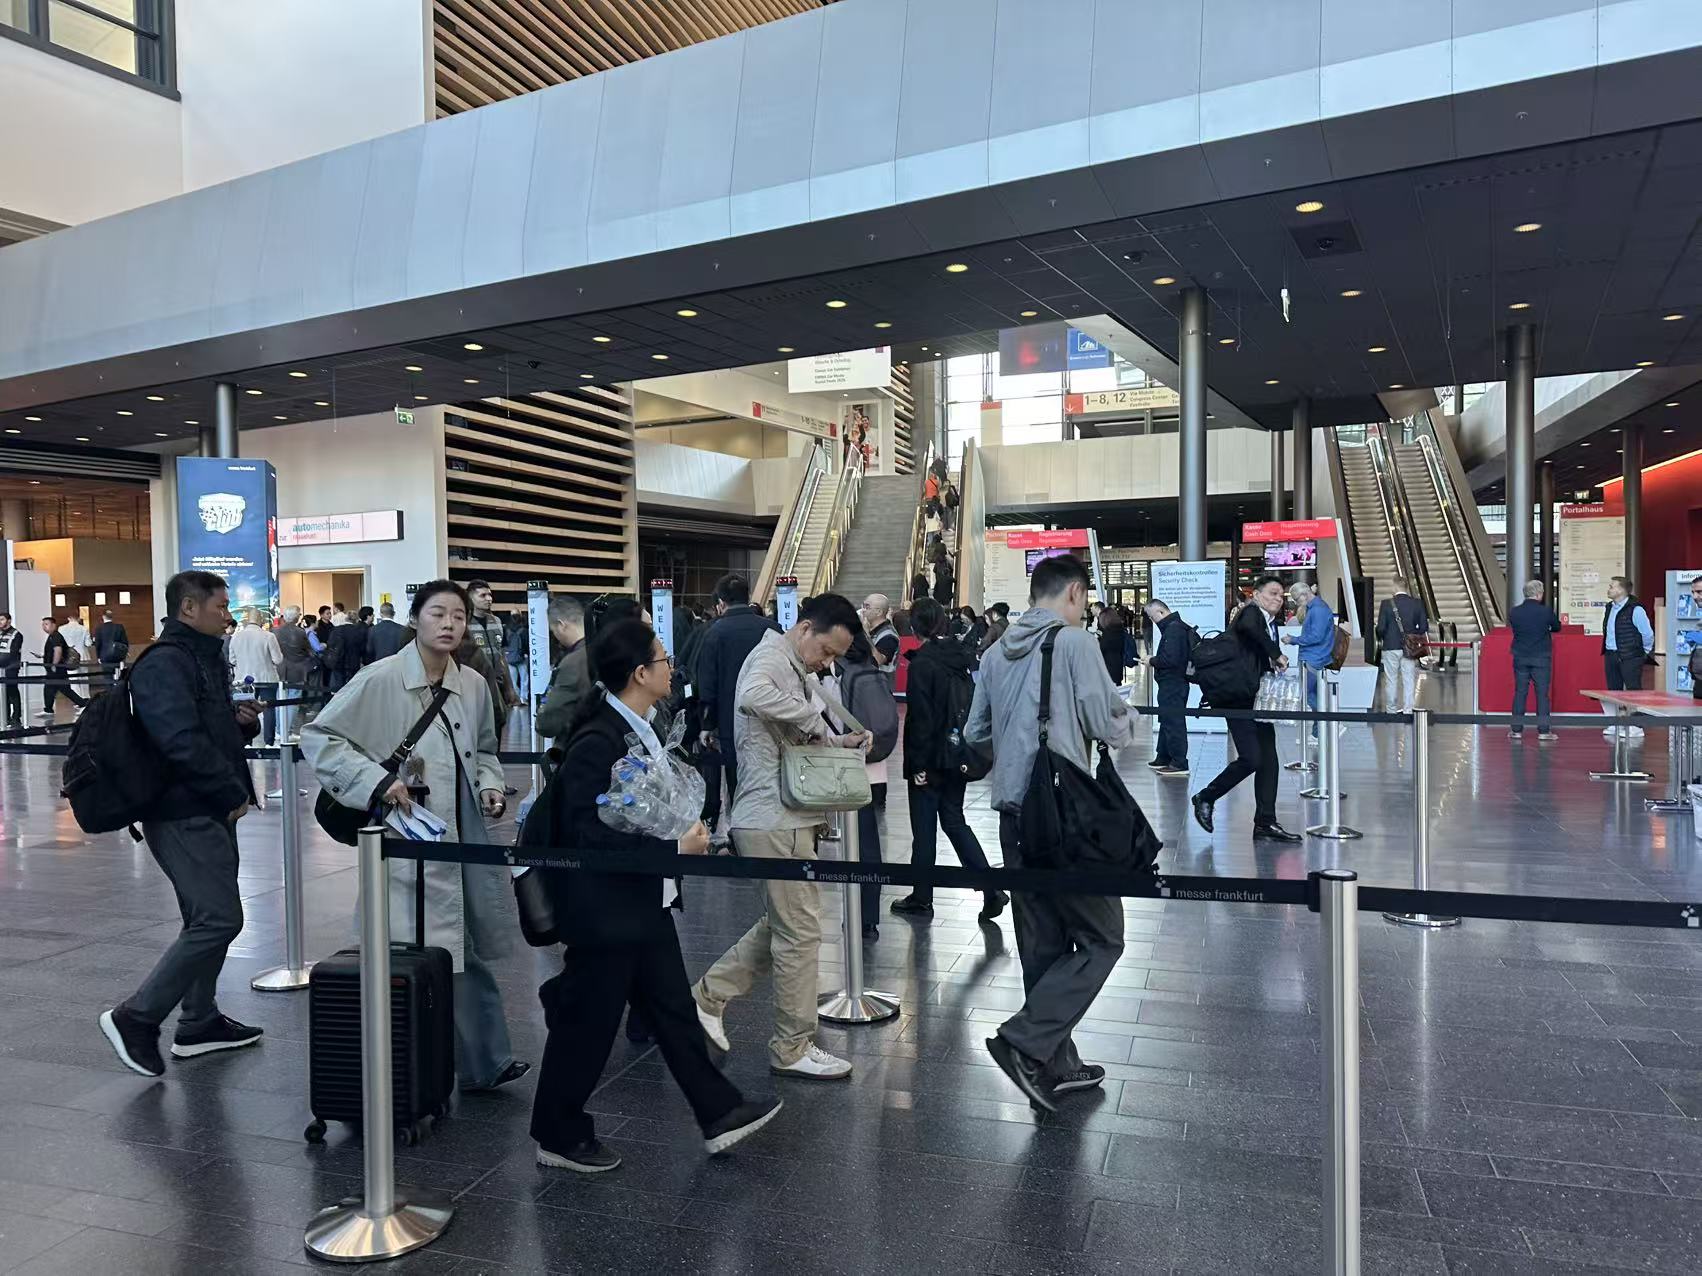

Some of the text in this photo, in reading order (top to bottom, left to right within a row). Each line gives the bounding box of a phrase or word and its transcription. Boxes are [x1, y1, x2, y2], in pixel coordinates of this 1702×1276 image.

[1113, 392, 1126, 403] 12
[292, 519, 350, 532] automechanika
[529, 607, 539, 677] WELCOME
[850, 872, 891, 883] frankfurt
[1175, 889, 1264, 901] messe frankfurt
